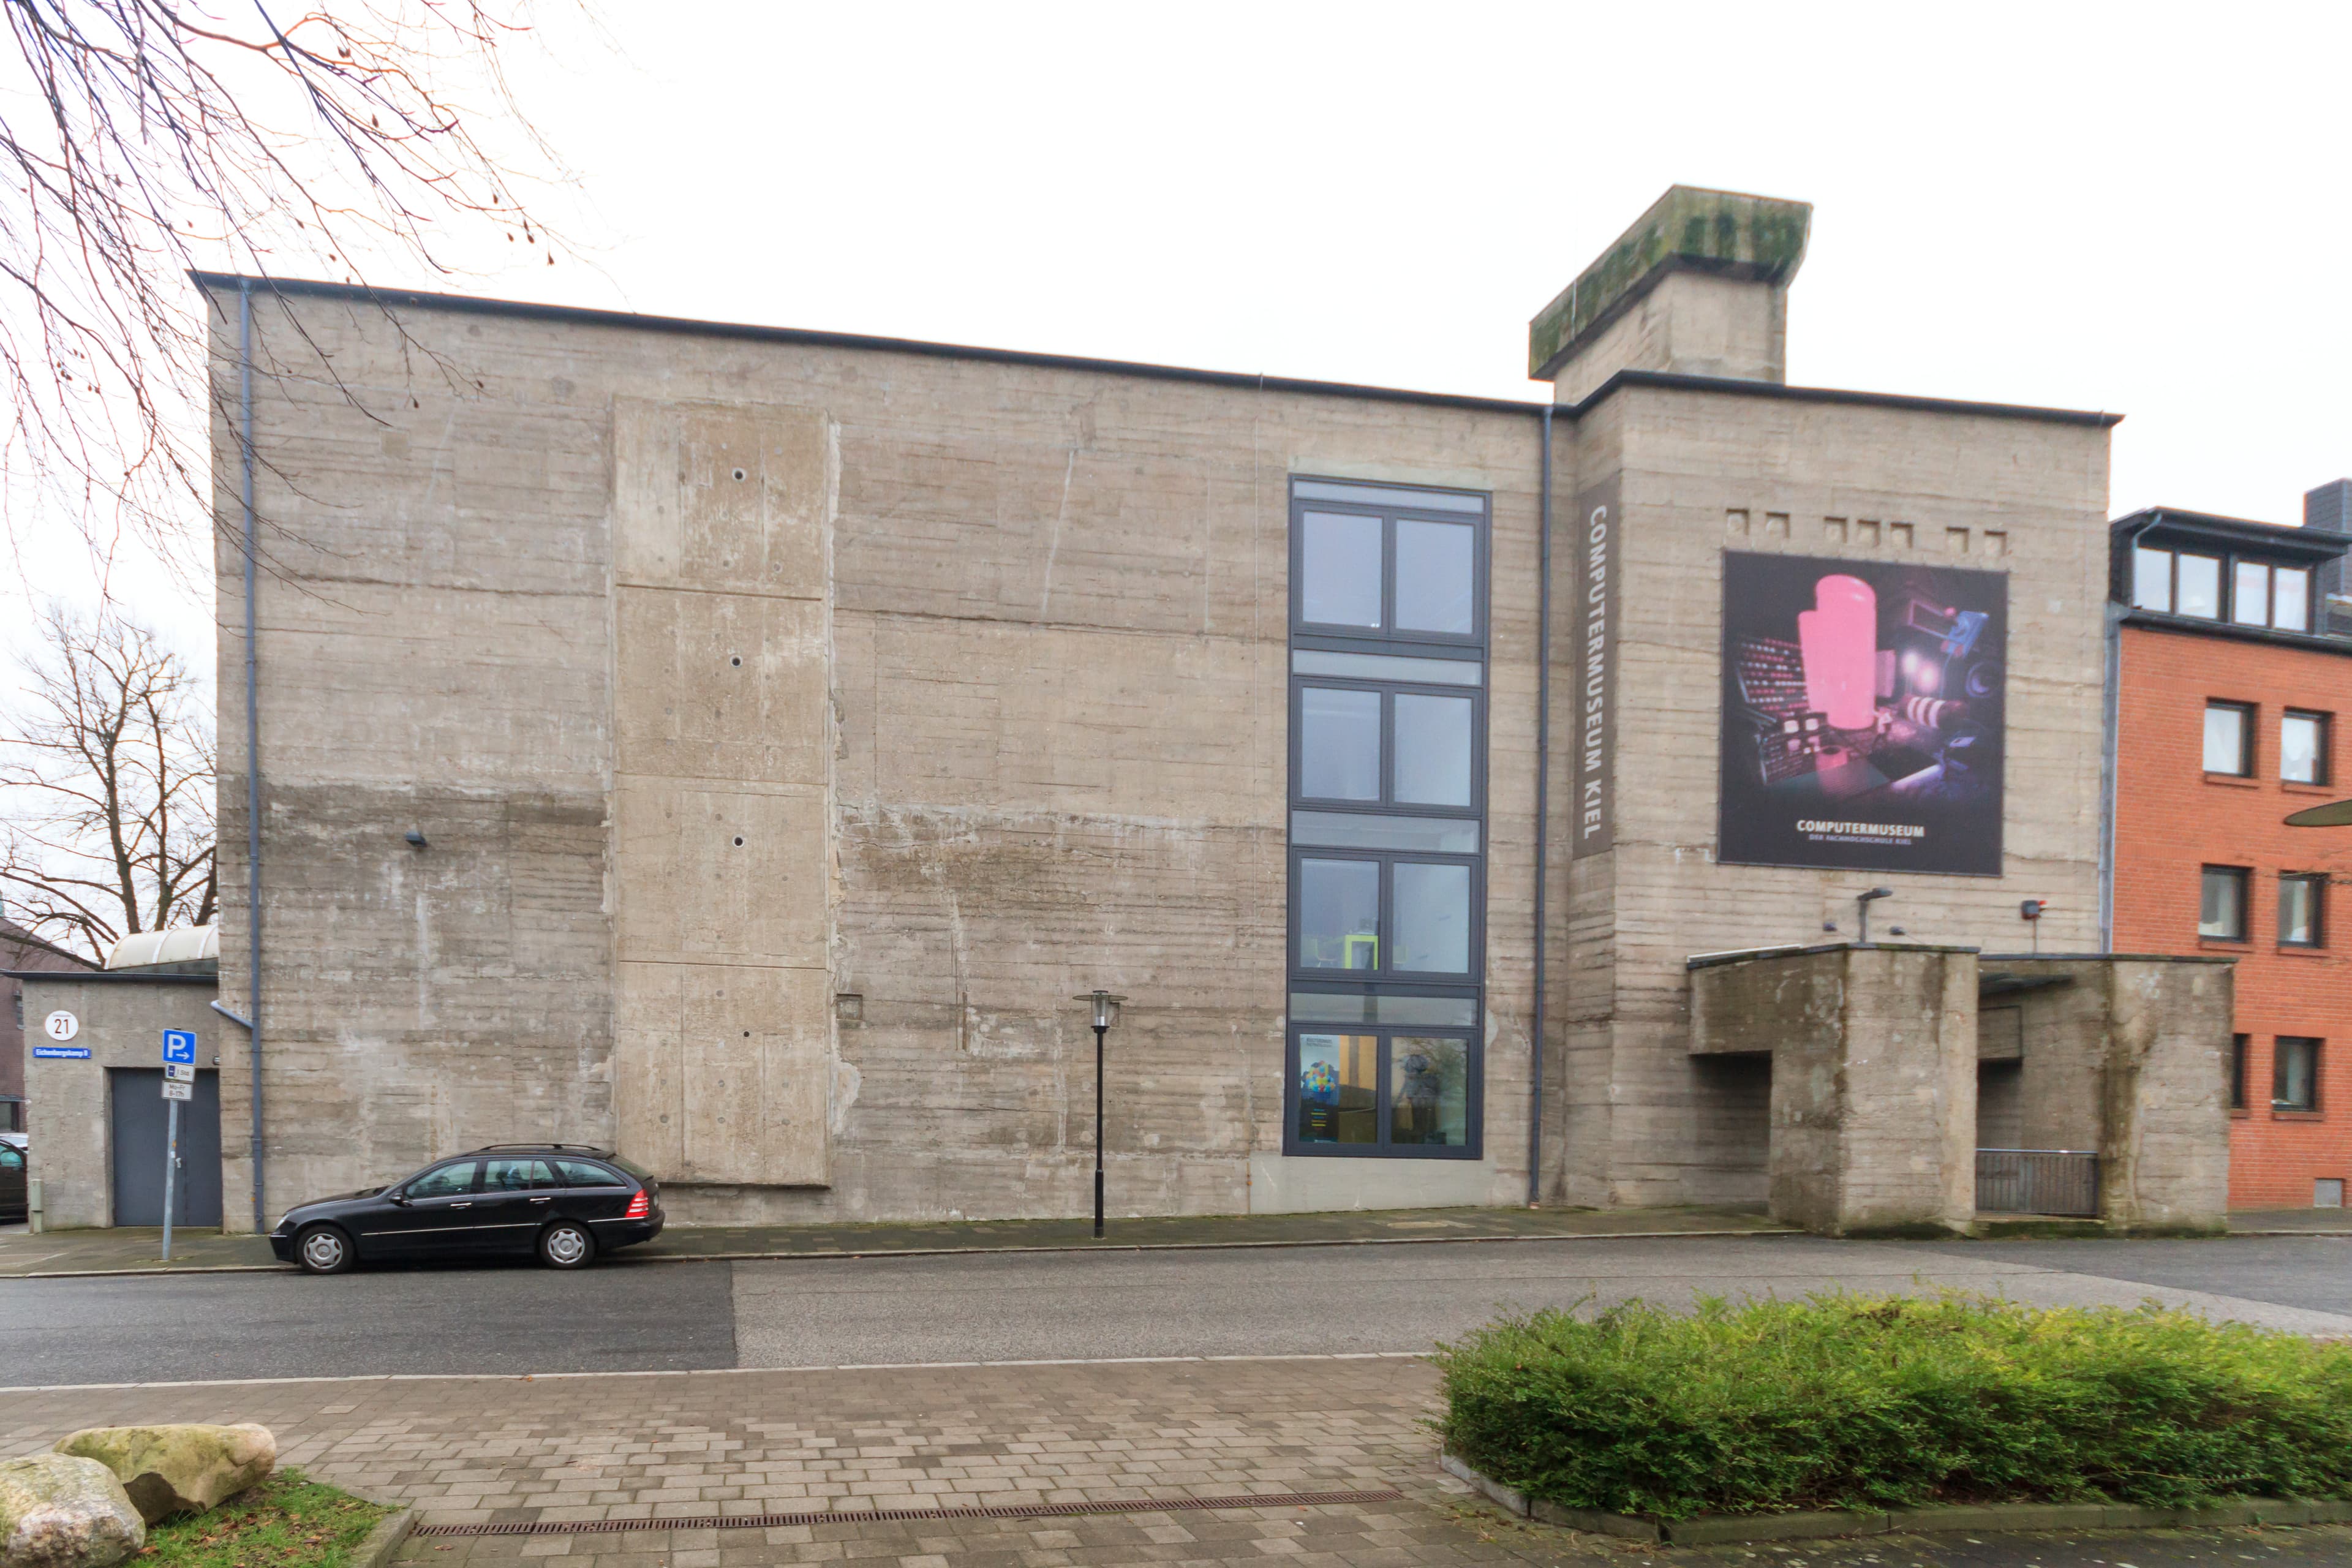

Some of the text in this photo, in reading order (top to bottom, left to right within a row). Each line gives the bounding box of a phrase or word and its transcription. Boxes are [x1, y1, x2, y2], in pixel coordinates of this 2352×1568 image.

[1585, 505, 1607, 840] COMPUTERMUSEUM KIEL
[1796, 820, 1925, 837] COMPUTERMUSEUM
[55, 1019, 69, 1034] 21
[167, 1033, 186, 1058] P
